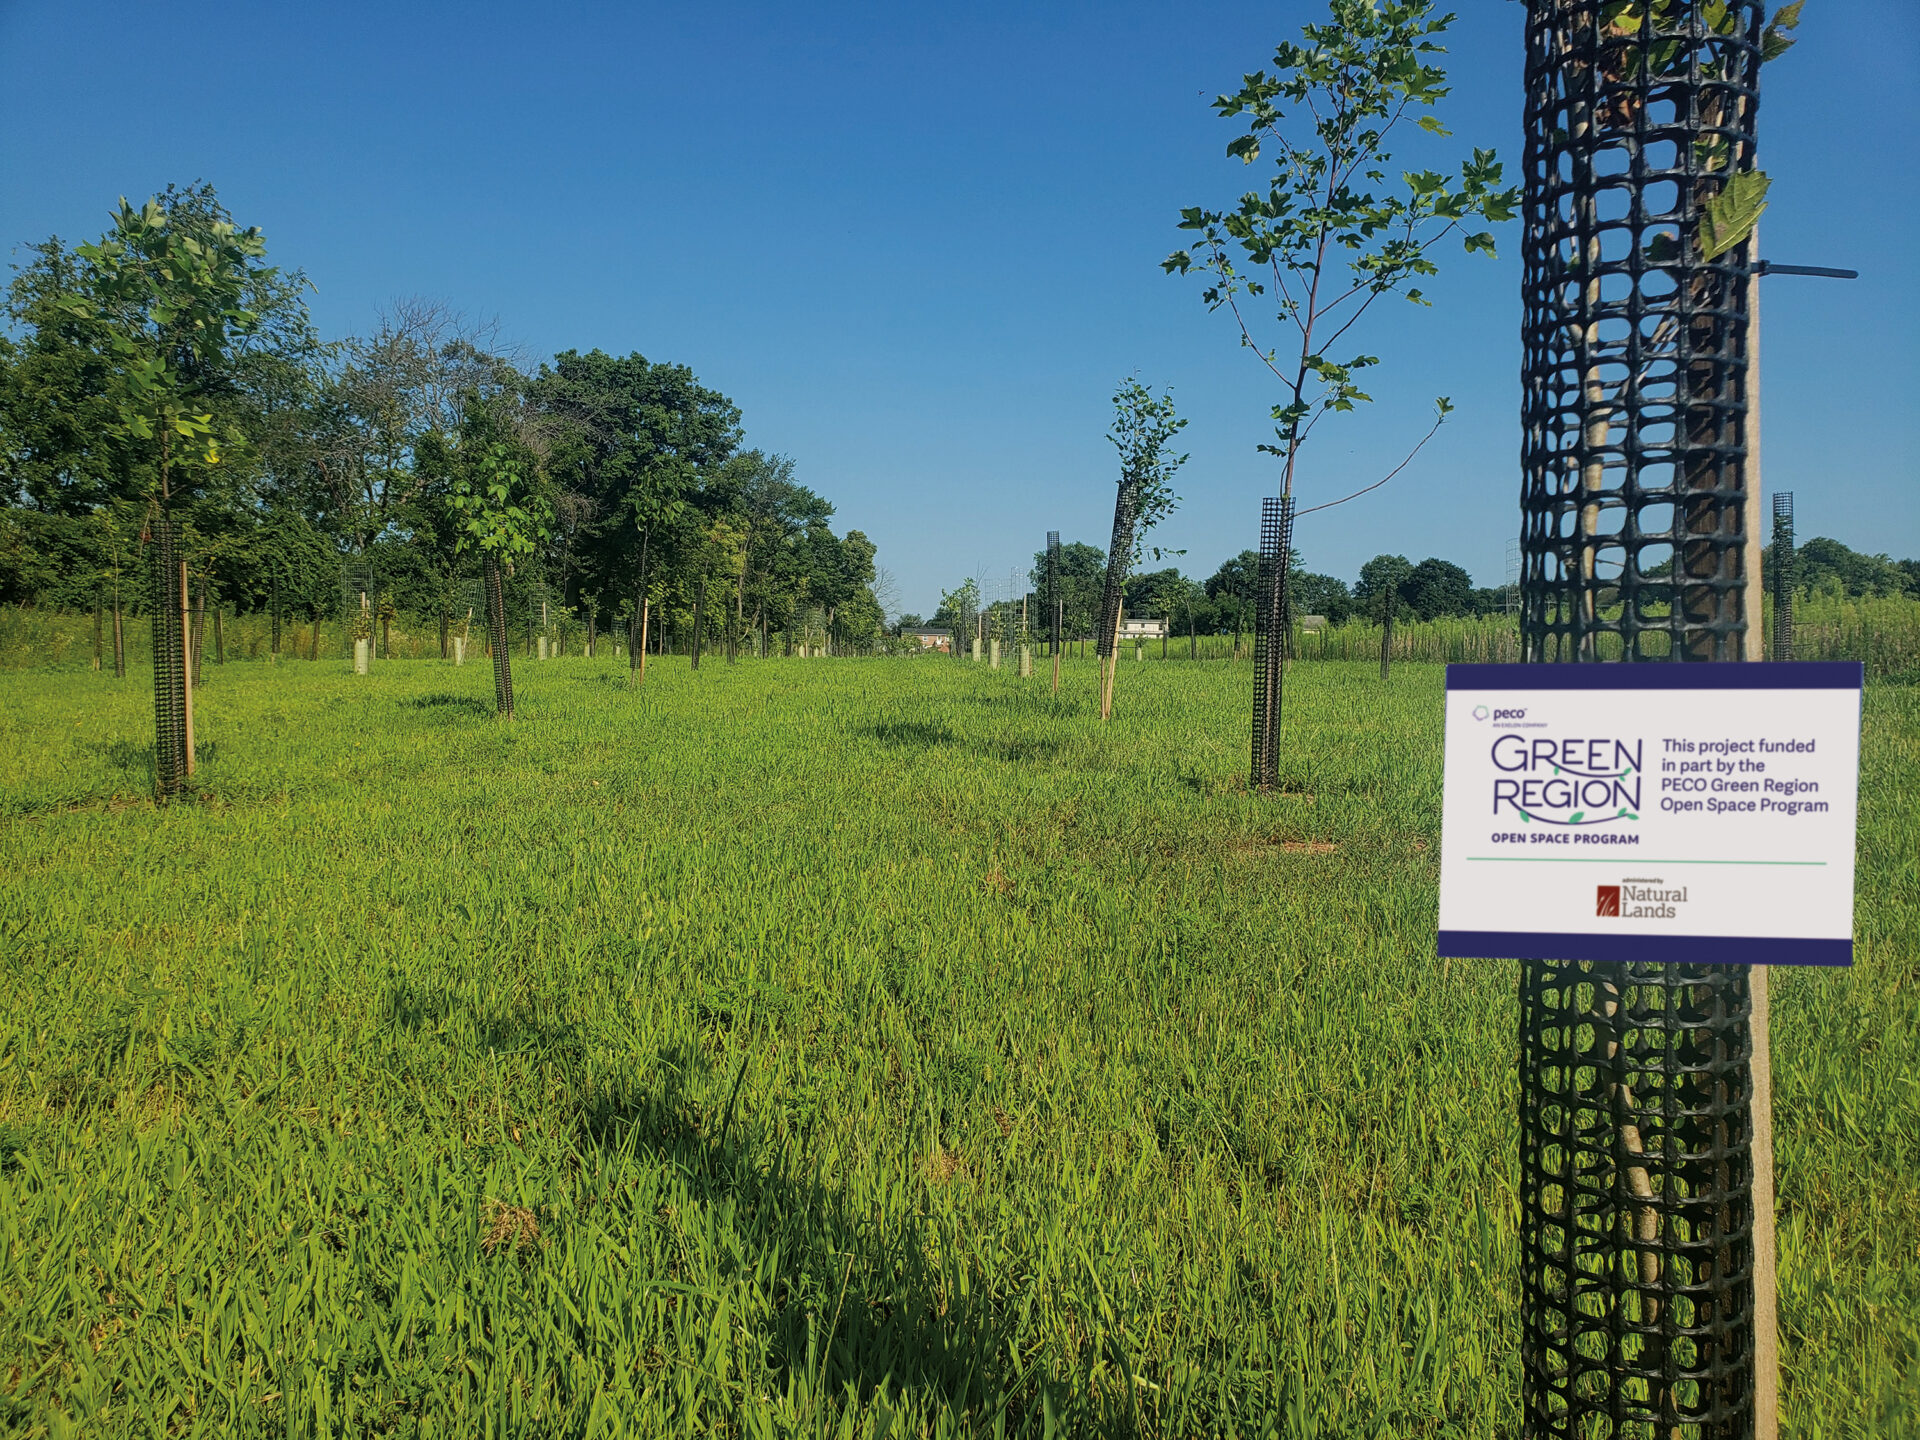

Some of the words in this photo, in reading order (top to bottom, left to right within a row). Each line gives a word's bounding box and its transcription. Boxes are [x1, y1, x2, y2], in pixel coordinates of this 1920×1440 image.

[1493, 708, 1525, 721] peco
[1491, 734, 1642, 777] GREEN
[1662, 738, 1695, 753] This
[1698, 738, 1755, 756] project
[1758, 738, 1816, 753] funded
[1661, 758, 1676, 772] in
[1680, 759, 1713, 775] part
[1716, 758, 1736, 776] by
[1738, 758, 1765, 772] the
[1661, 777, 1707, 792] PECO
[1711, 778, 1759, 792] Green
[1763, 778, 1819, 796] Region
[1493, 776, 1641, 824] REGION
[1660, 797, 1703, 814] Open
[1706, 797, 1756, 815] Space
[1760, 798, 1829, 816] Program
[1491, 832, 1526, 844] OPEN
[1530, 832, 1570, 844] SPACE
[1574, 833, 1640, 845] PROGRAM
[1656, 877, 1664, 885] by
[1622, 885, 1688, 902] Natural
[1621, 902, 1676, 919] Lands
